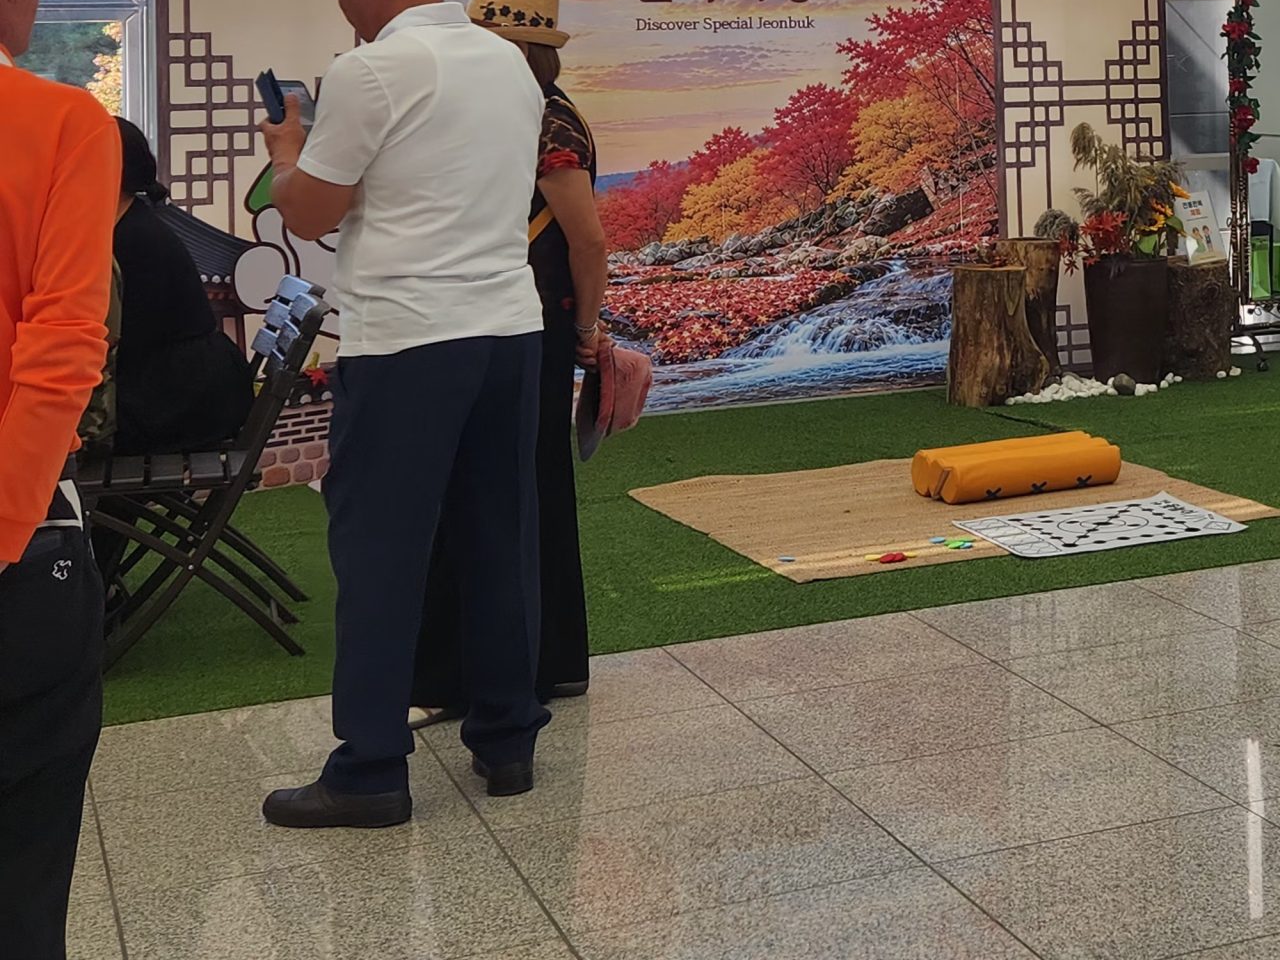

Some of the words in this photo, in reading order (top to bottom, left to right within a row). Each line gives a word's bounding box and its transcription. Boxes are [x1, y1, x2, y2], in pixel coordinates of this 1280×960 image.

[635, 17, 699, 32] Discover
[702, 16, 753, 34] Special
[756, 15, 816, 31] Jeonbuk
